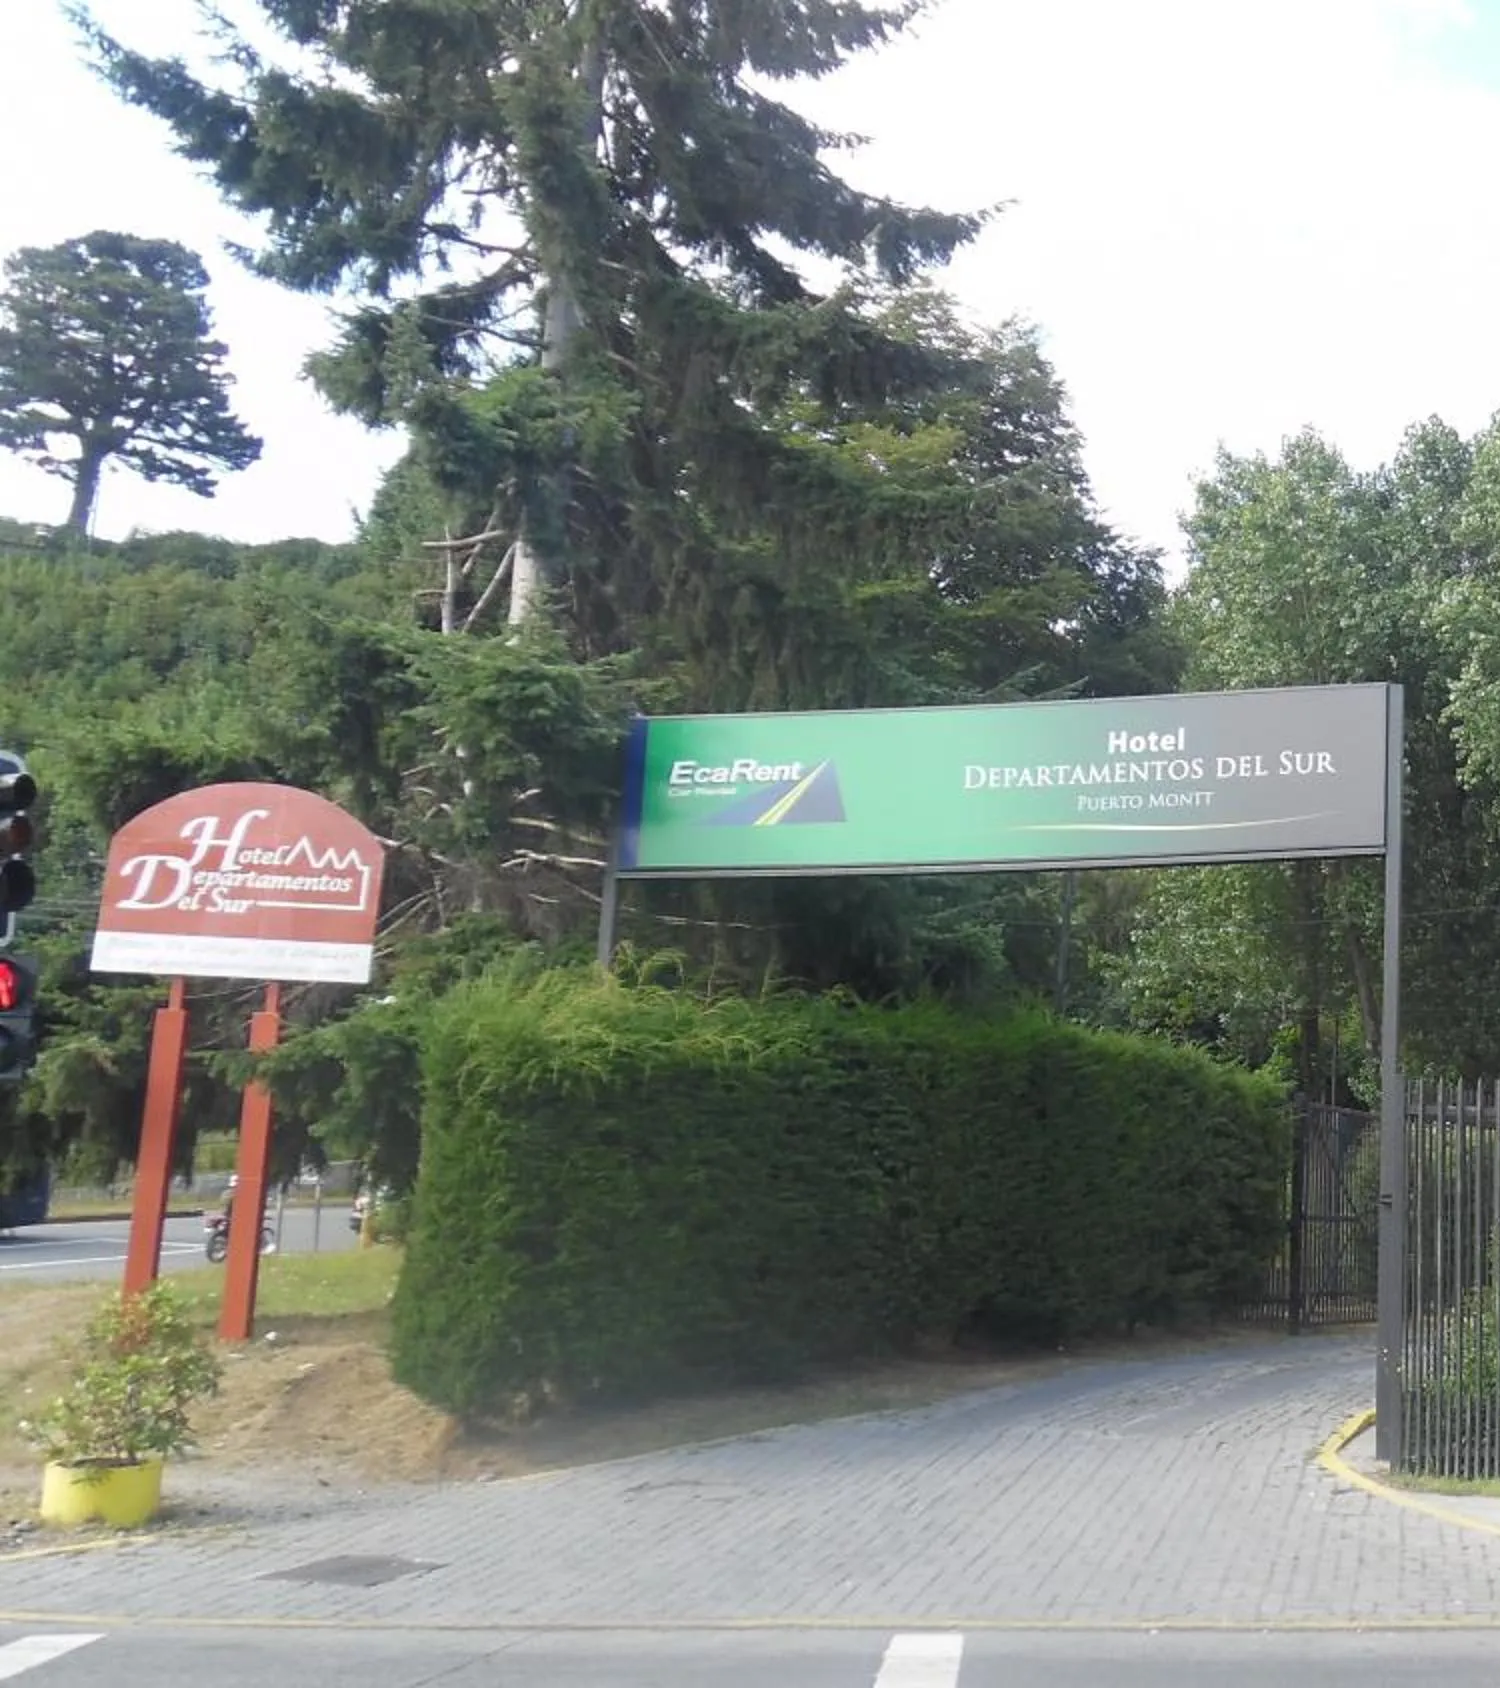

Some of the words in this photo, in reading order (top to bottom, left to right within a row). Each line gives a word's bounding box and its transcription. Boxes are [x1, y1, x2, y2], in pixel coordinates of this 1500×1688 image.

[1107, 728, 1186, 754] Hotel
[669, 758, 801, 785] EcaRent
[180, 809, 289, 872] Hotel
[116, 855, 353, 909] Departamentos
[204, 886, 255, 914] Sur
